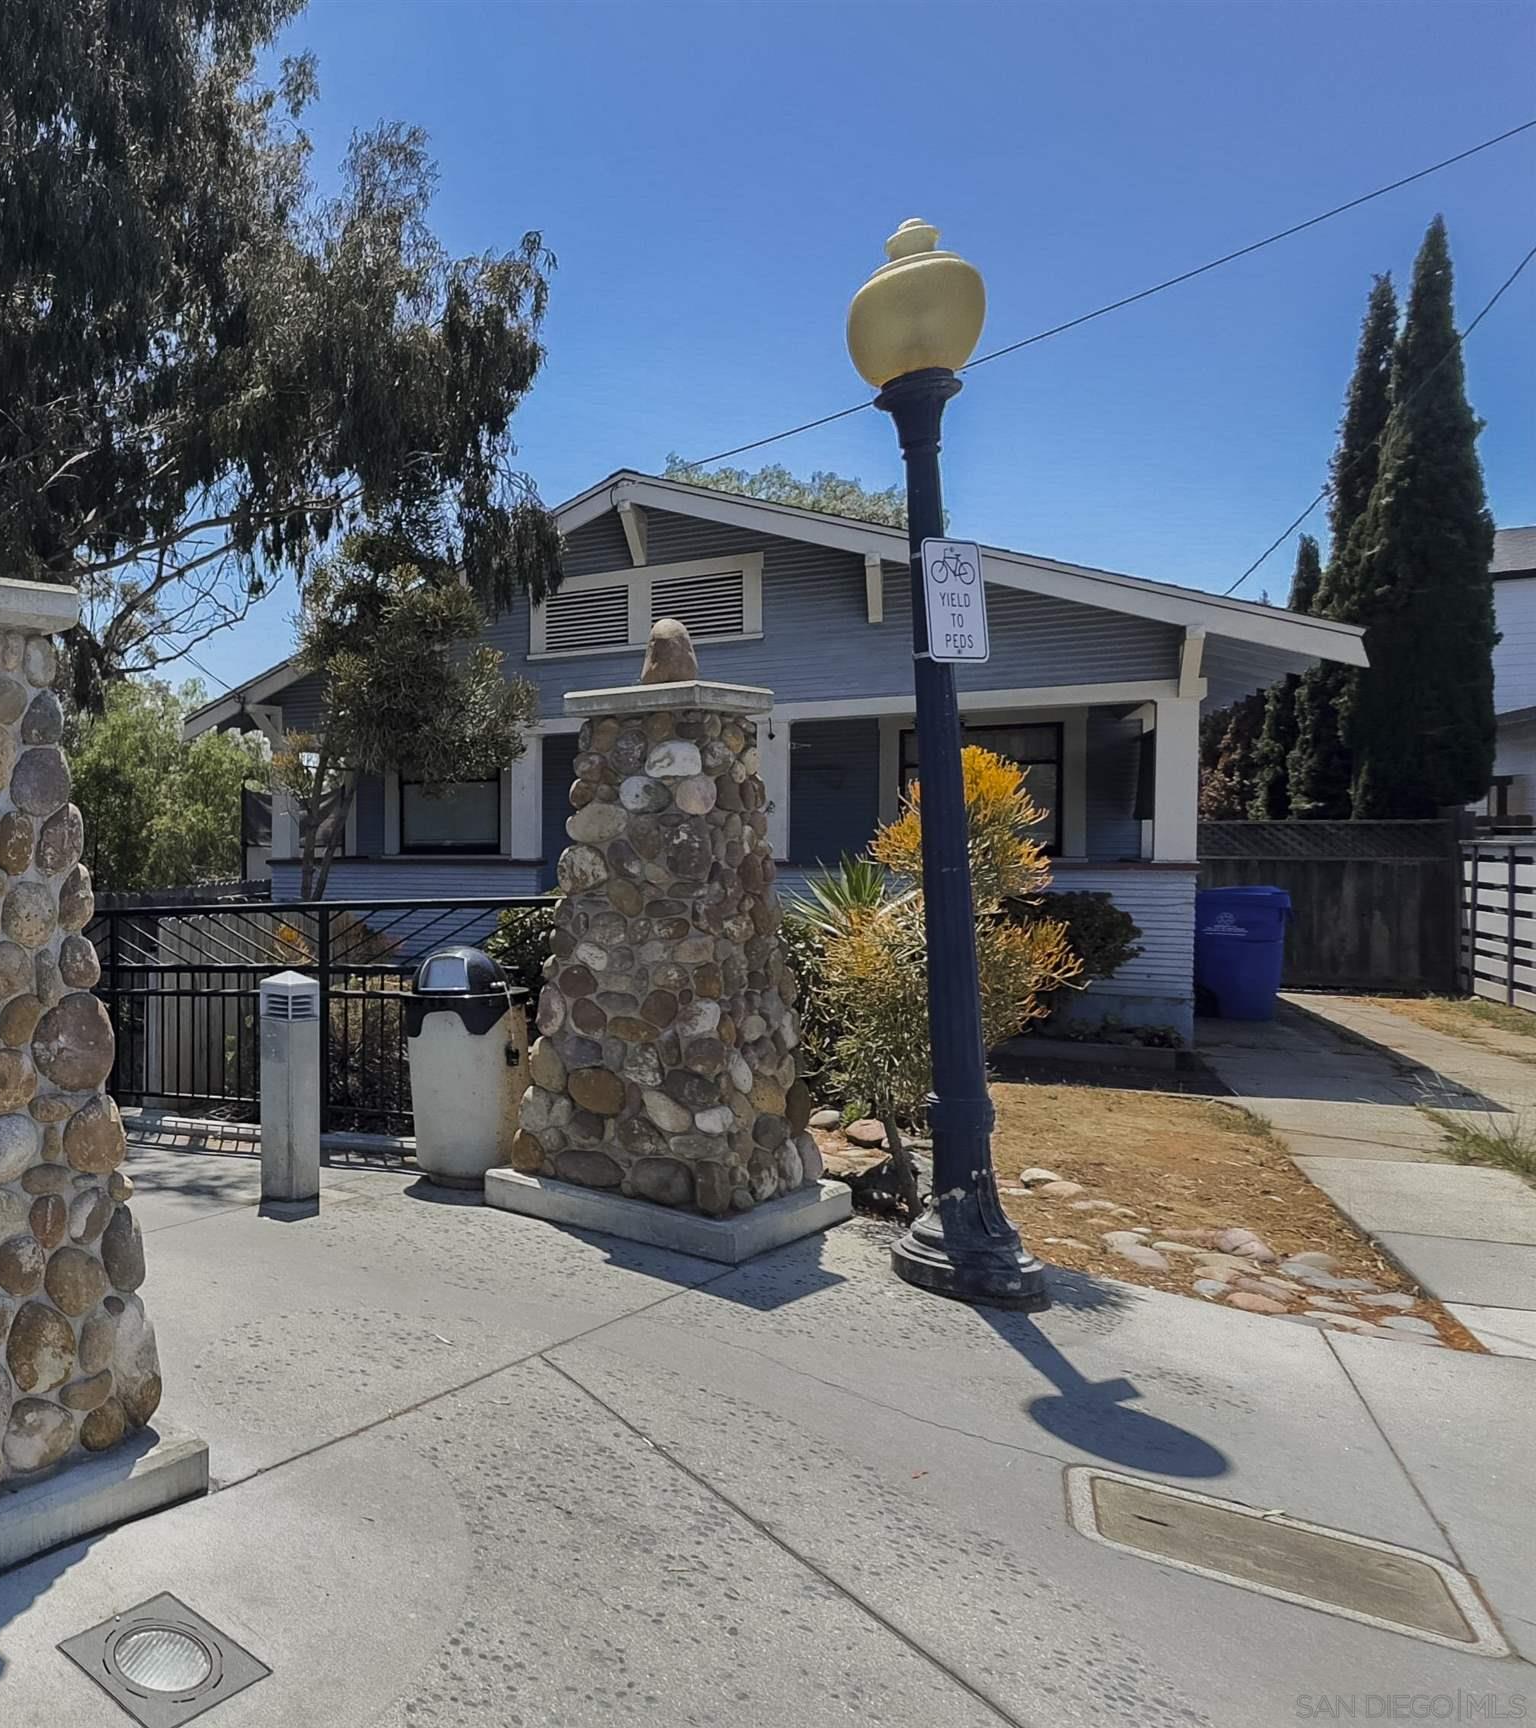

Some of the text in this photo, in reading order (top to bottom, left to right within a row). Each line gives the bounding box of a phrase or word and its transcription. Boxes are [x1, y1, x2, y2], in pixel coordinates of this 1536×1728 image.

[939, 592, 971, 608] YIELD
[951, 613, 964, 628] TO
[945, 633, 974, 649] PEDS
